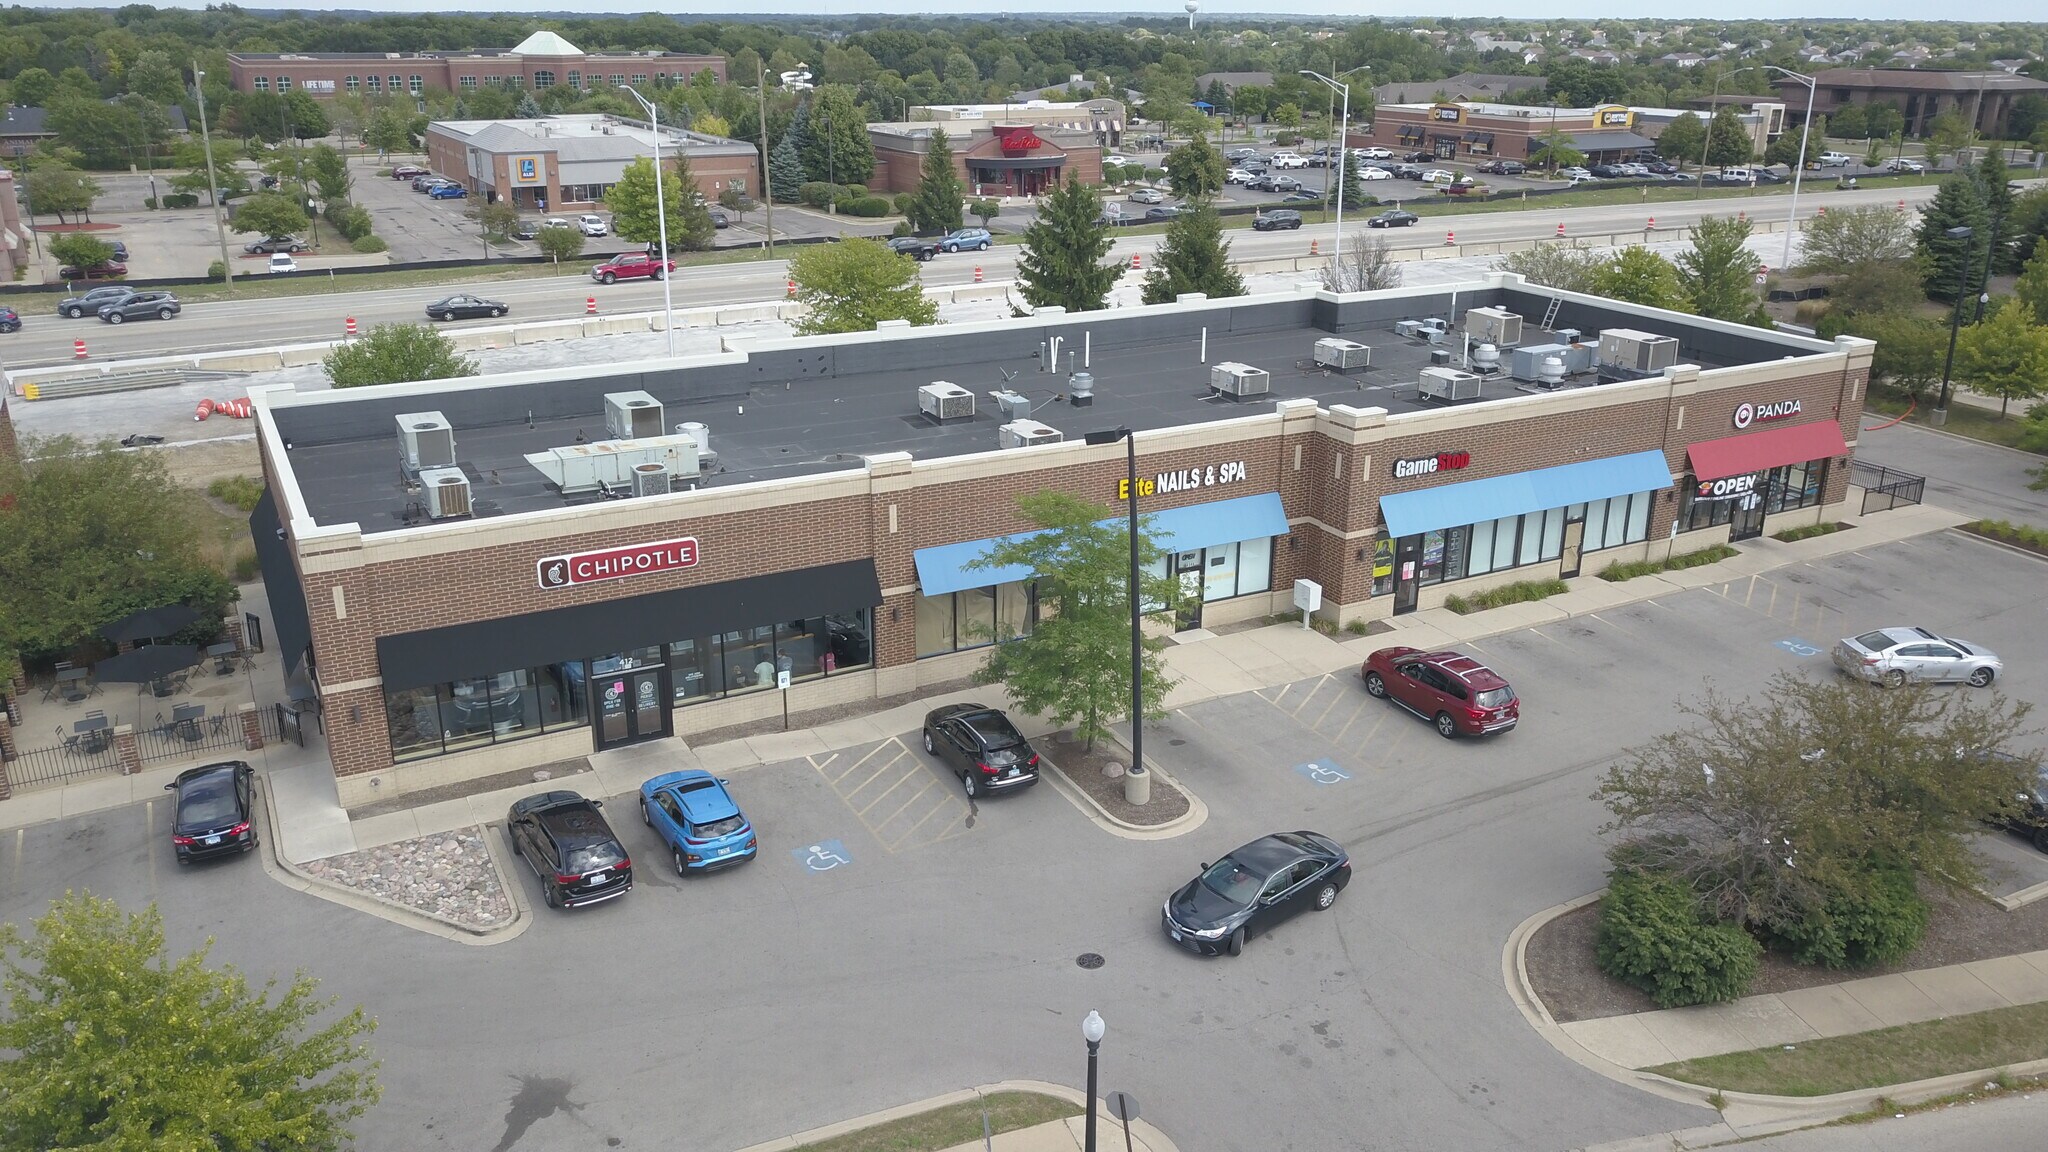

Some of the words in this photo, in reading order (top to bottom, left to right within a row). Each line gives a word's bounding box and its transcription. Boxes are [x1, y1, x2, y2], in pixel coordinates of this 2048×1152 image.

[301, 80, 336, 89] LIFETIME
[1756, 399, 1801, 419] PANDA
[1395, 452, 1470, 478] GameStop
[1119, 477, 1154, 500] Eite
[1157, 467, 1200, 494] NAILS
[1204, 465, 1215, 486] &
[1219, 460, 1246, 484] SPA
[1713, 474, 1757, 496] OPEN
[577, 547, 693, 577] CHIPOTLE
[619, 657, 633, 665] 412
